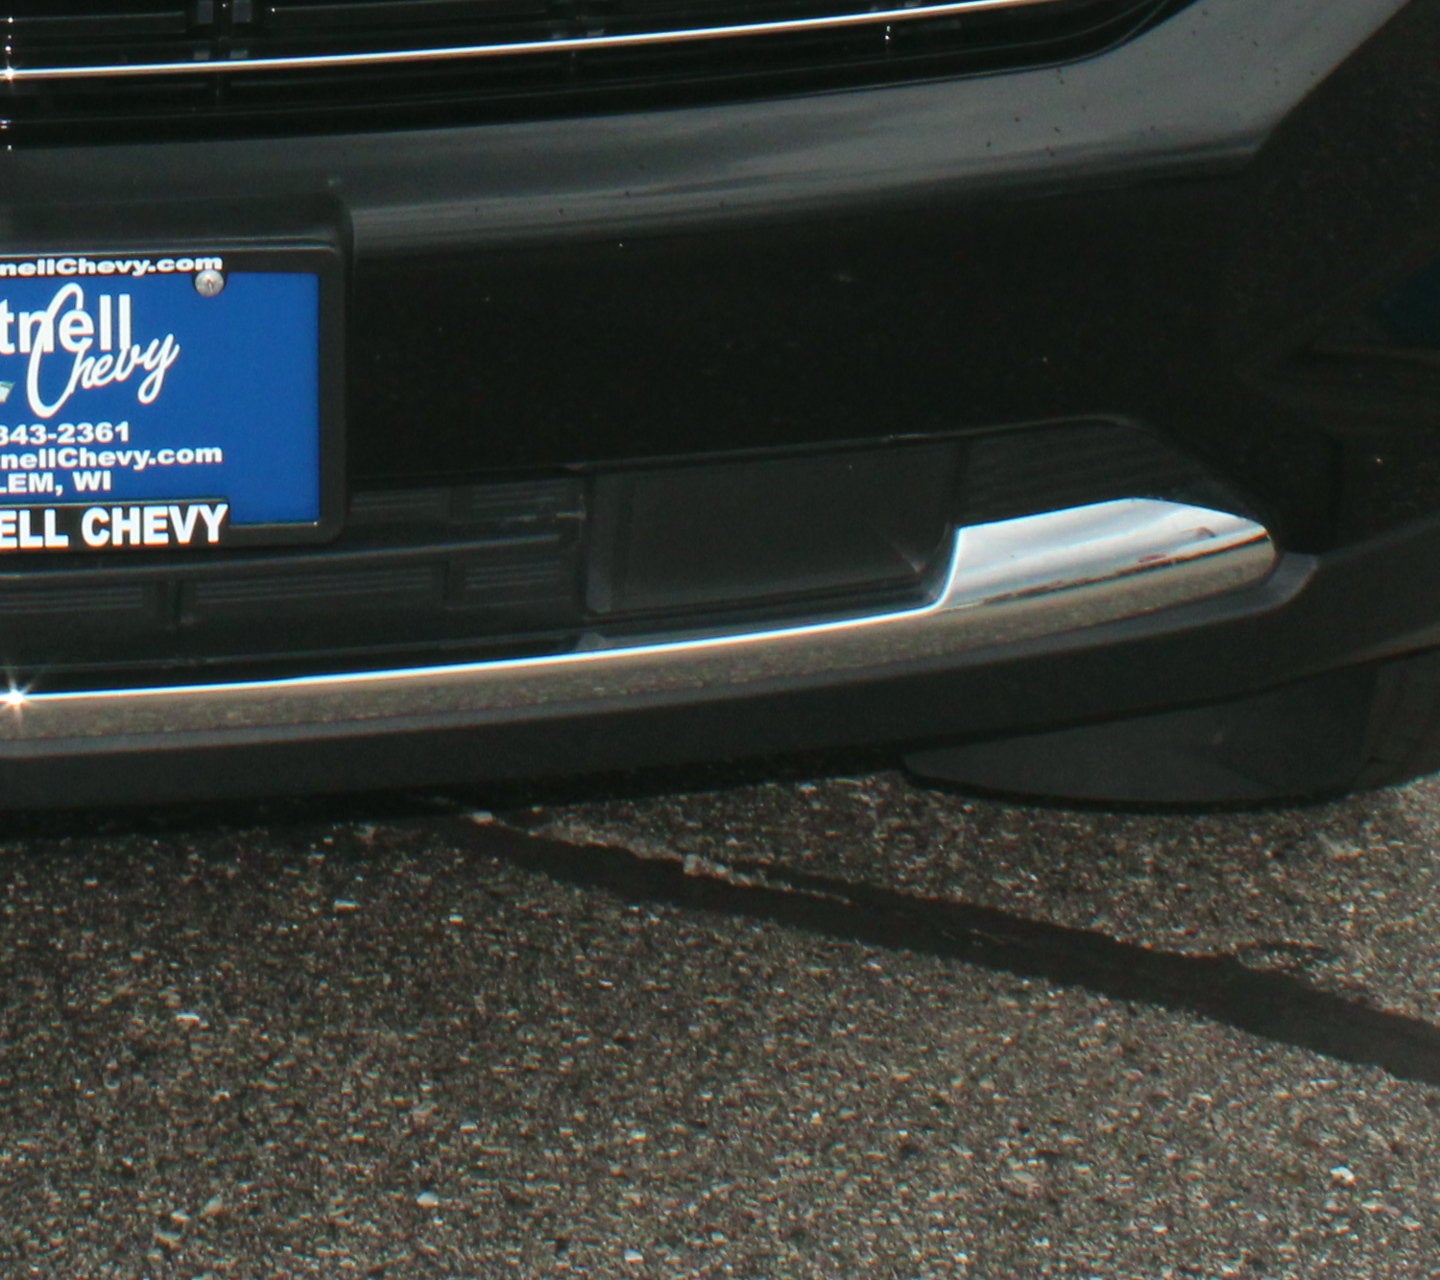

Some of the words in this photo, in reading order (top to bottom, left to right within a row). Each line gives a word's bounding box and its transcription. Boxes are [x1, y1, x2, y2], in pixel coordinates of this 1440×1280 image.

[26, 282, 180, 418] Chevy
[72, 470, 111, 492] WI
[81, 503, 229, 547] CHEVY
